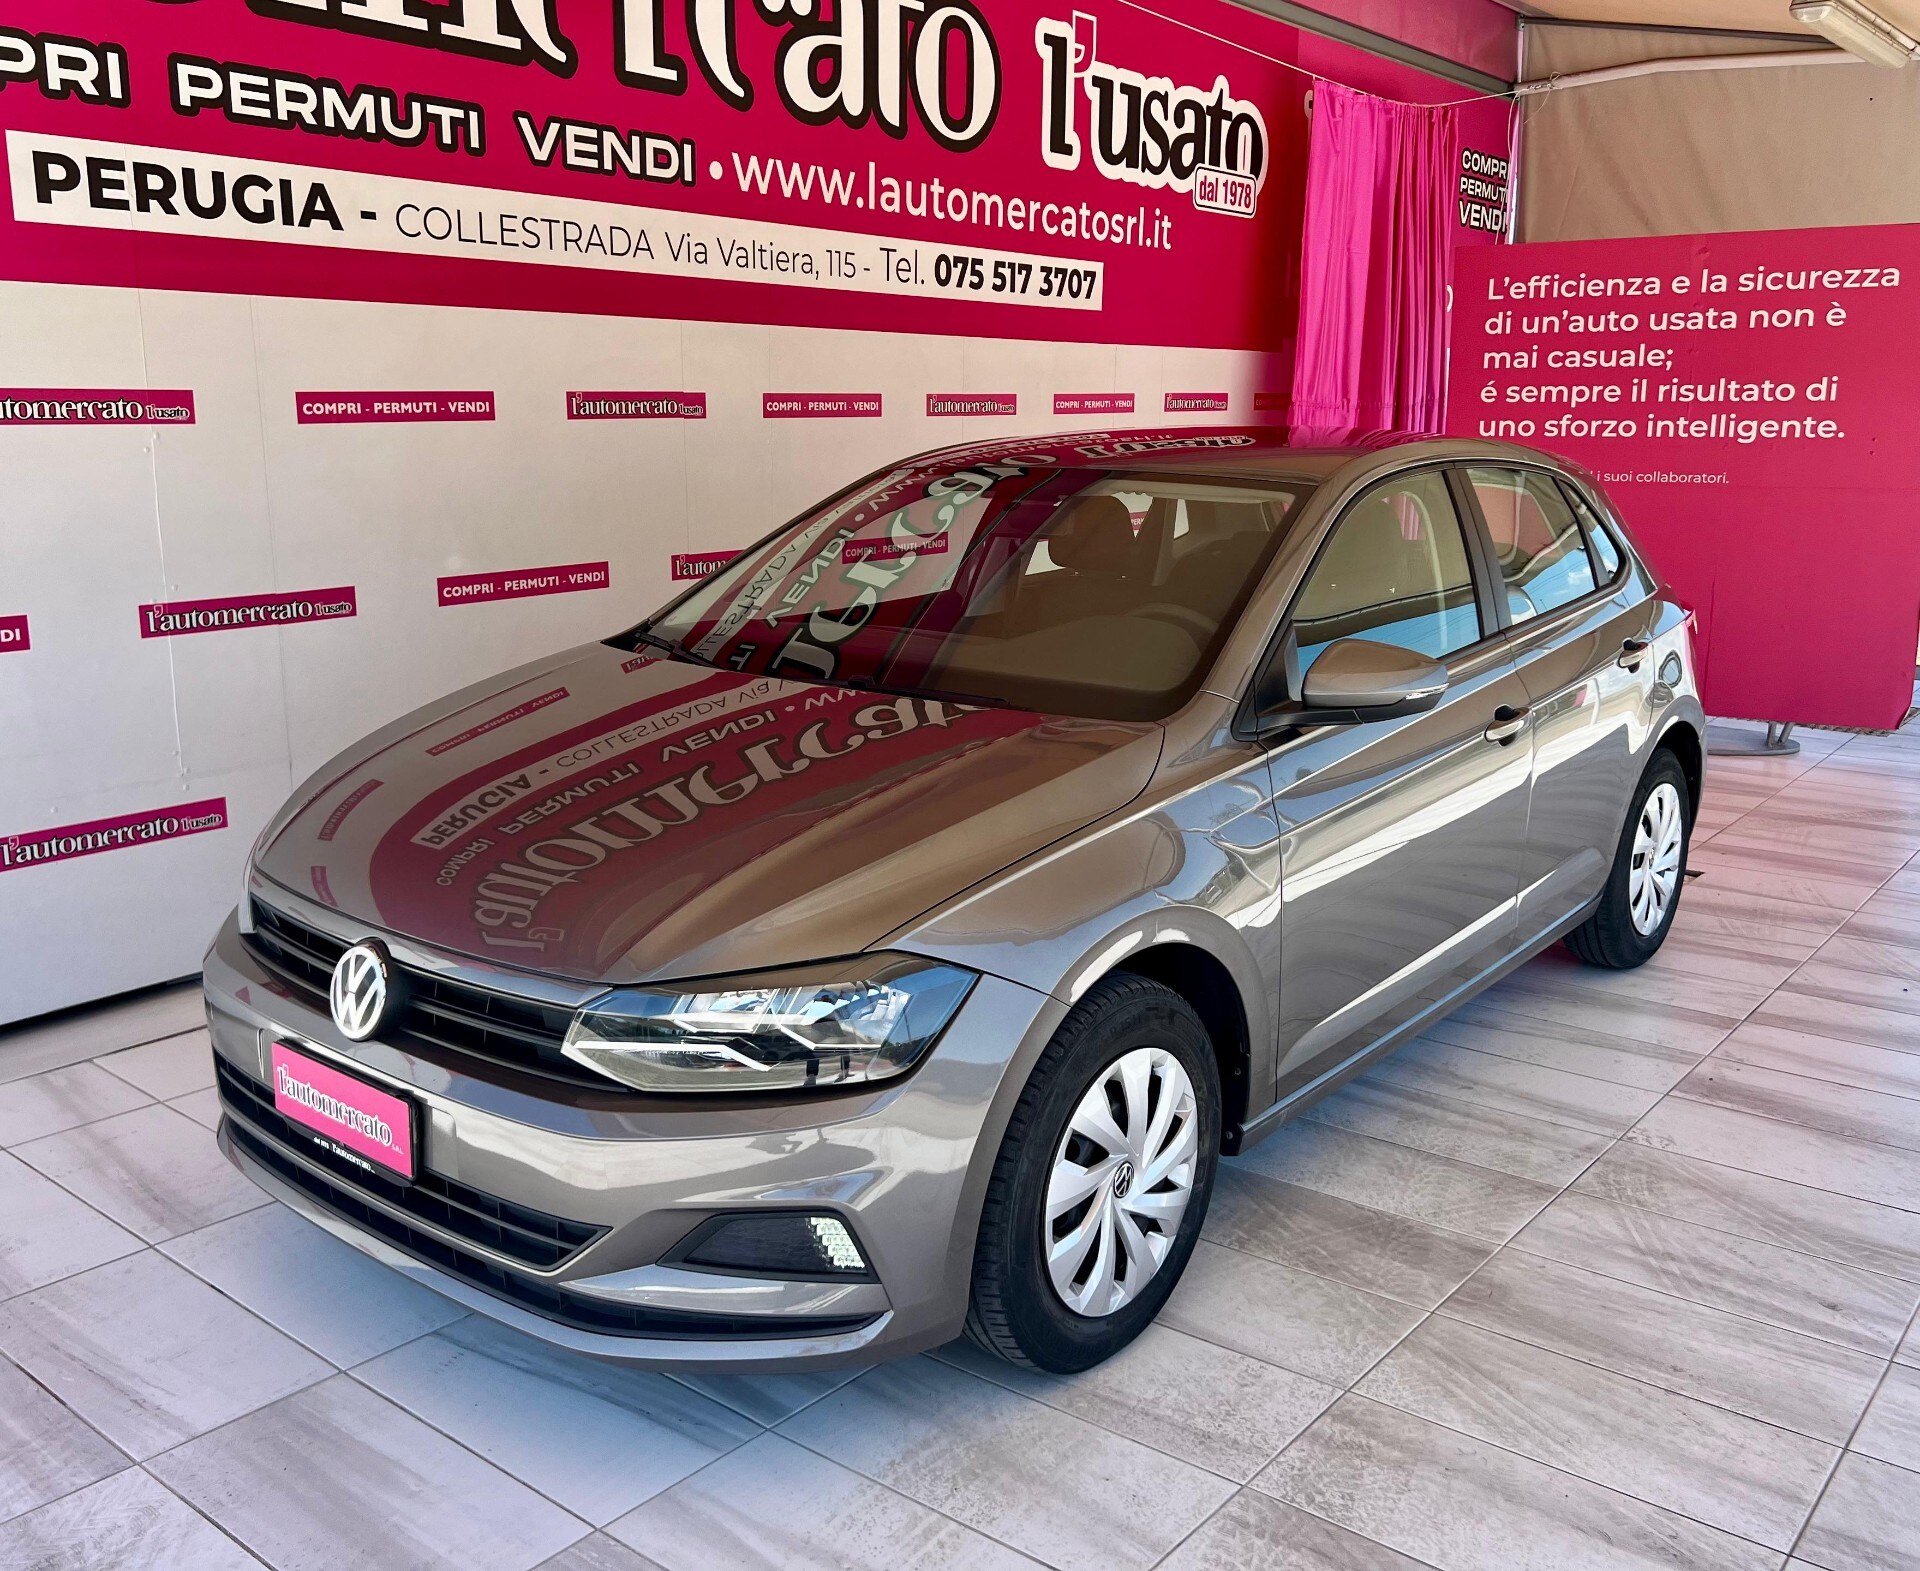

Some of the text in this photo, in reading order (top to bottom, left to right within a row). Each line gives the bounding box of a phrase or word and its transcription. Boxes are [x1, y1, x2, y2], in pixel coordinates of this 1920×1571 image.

[1040, 10, 1266, 183] l'usato
[176, 62, 481, 149] PERMUTI
[517, 116, 695, 182] VENDI
[732, 151, 1172, 250] www.lautomercatosrl.it
[1199, 176, 1252, 209] dal 1978
[31, 150, 344, 231] PERUGIA
[395, 203, 655, 261] COLLESTRADA
[664, 231, 709, 264] Via
[716, 238, 820, 280] Valtiera,
[826, 248, 857, 279] 115
[880, 246, 925, 284] Tel.
[934, 253, 985, 290] 075
[991, 259, 1032, 295] 517
[1038, 264, 1097, 301] 3707
[1459, 200, 1506, 233] VENDI
[1488, 265, 1901, 300] L'efficienza e la sicurezza
[1484, 311, 1512, 335] di
[1649, 307, 1738, 332] usata
[1748, 306, 1815, 329] non
[1825, 302, 1847, 327] è
[1483, 344, 1674, 372] mai casuale;
[302, 402, 361, 415] COMPRI
[373, 401, 437, 415] PERMUTI
[448, 401, 490, 413] VENDI
[571, 392, 677, 416] l'automercato
[766, 401, 801, 411] COMPRI
[808, 401, 847, 411] PERMUTI
[853, 401, 878, 410] VENDI
[930, 395, 998, 414] l'automercato
[1055, 401, 1079, 409] COMPRI
[1084, 401, 1111, 409] PERMUTI
[1114, 400, 1133, 408] VENDI
[1480, 376, 1838, 408] é sempre il risultato di
[1479, 413, 1846, 444] uno sforzo intelligente.
[1603, 470, 1633, 483] suoi
[1635, 471, 1730, 484] collaboratori.
[442, 582, 494, 598] COMPRI
[504, 575, 559, 592] PERMUTI
[568, 571, 605, 585] VENDI
[0, 812, 223, 866] l'automercato l'usato
[277, 1064, 393, 1147] l'automercato
